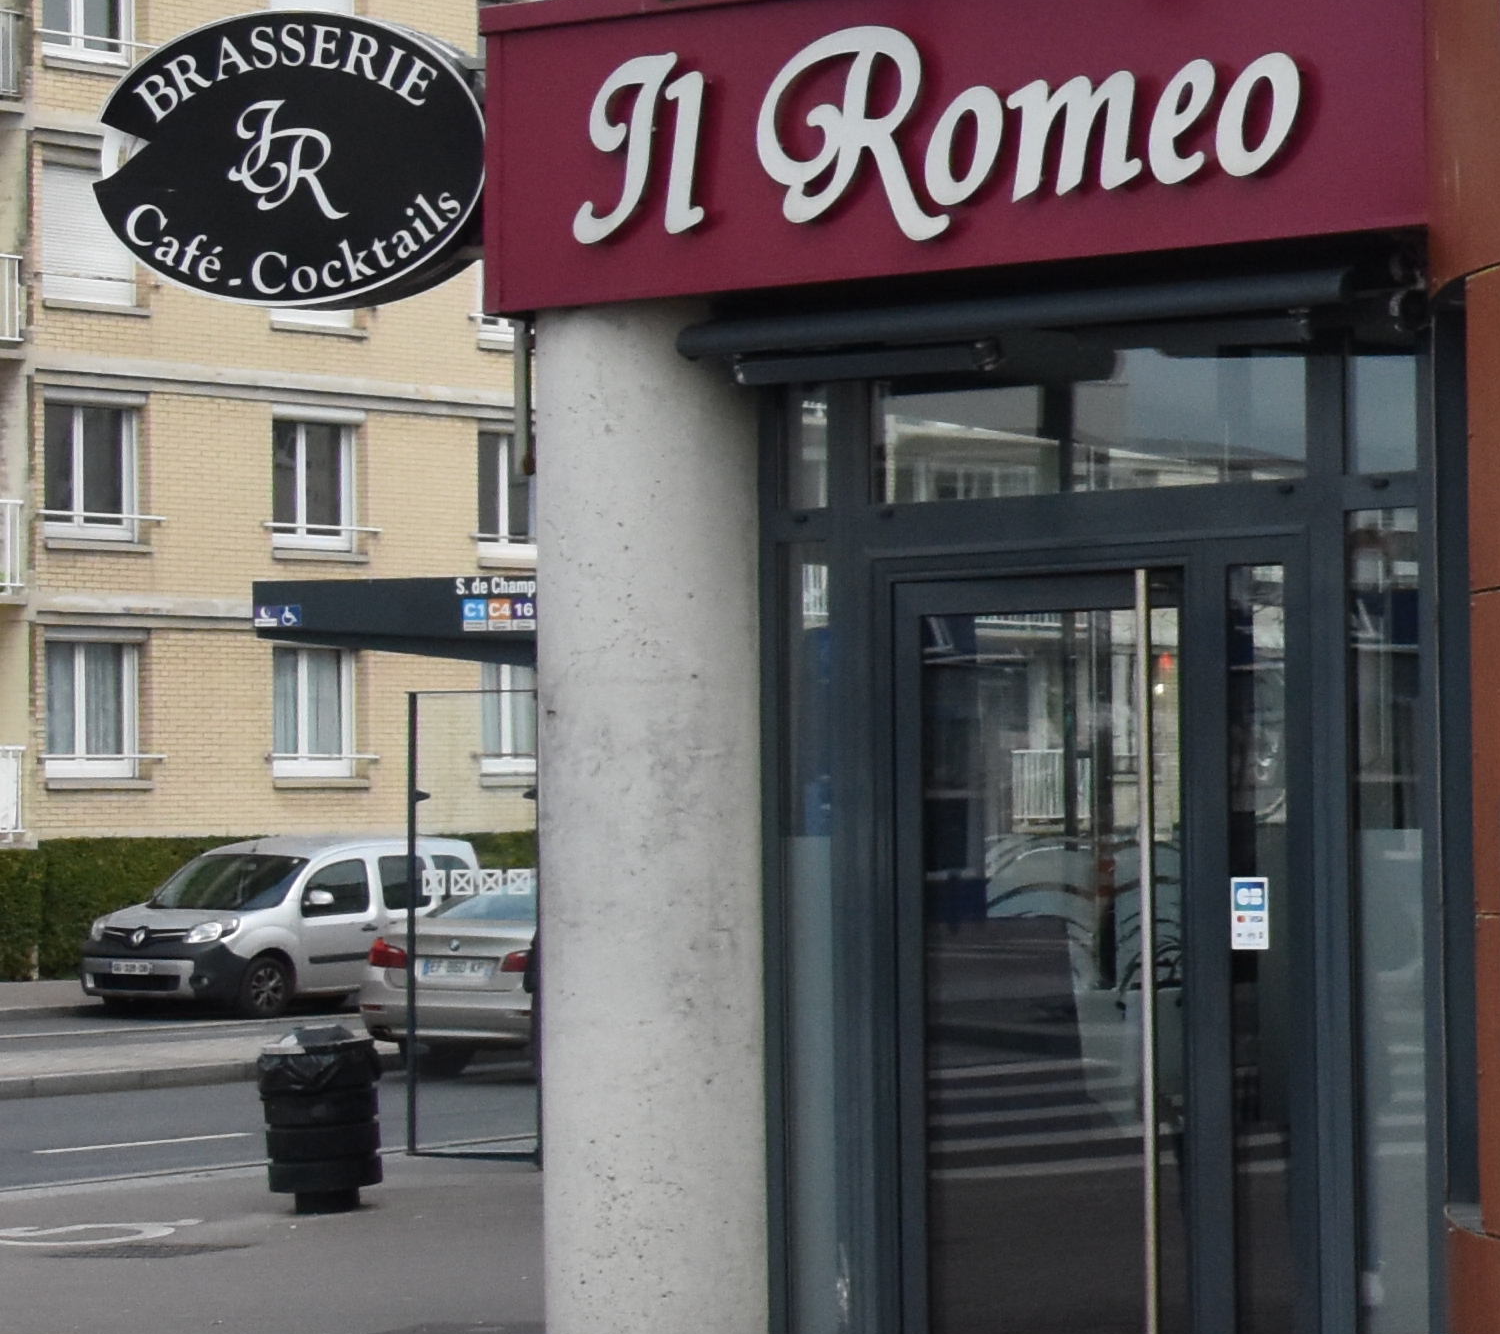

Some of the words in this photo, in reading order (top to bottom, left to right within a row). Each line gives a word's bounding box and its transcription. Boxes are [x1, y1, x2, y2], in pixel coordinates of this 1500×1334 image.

[133, 24, 437, 123] BRASSERIE
[756, 26, 1300, 241] Romeo
[126, 203, 221, 283] Café
[252, 190, 461, 294] Cocktails
[464, 602, 485, 617] C1
[488, 602, 511, 617] C4
[515, 602, 534, 617] 16
[472, 578, 488, 594] de
